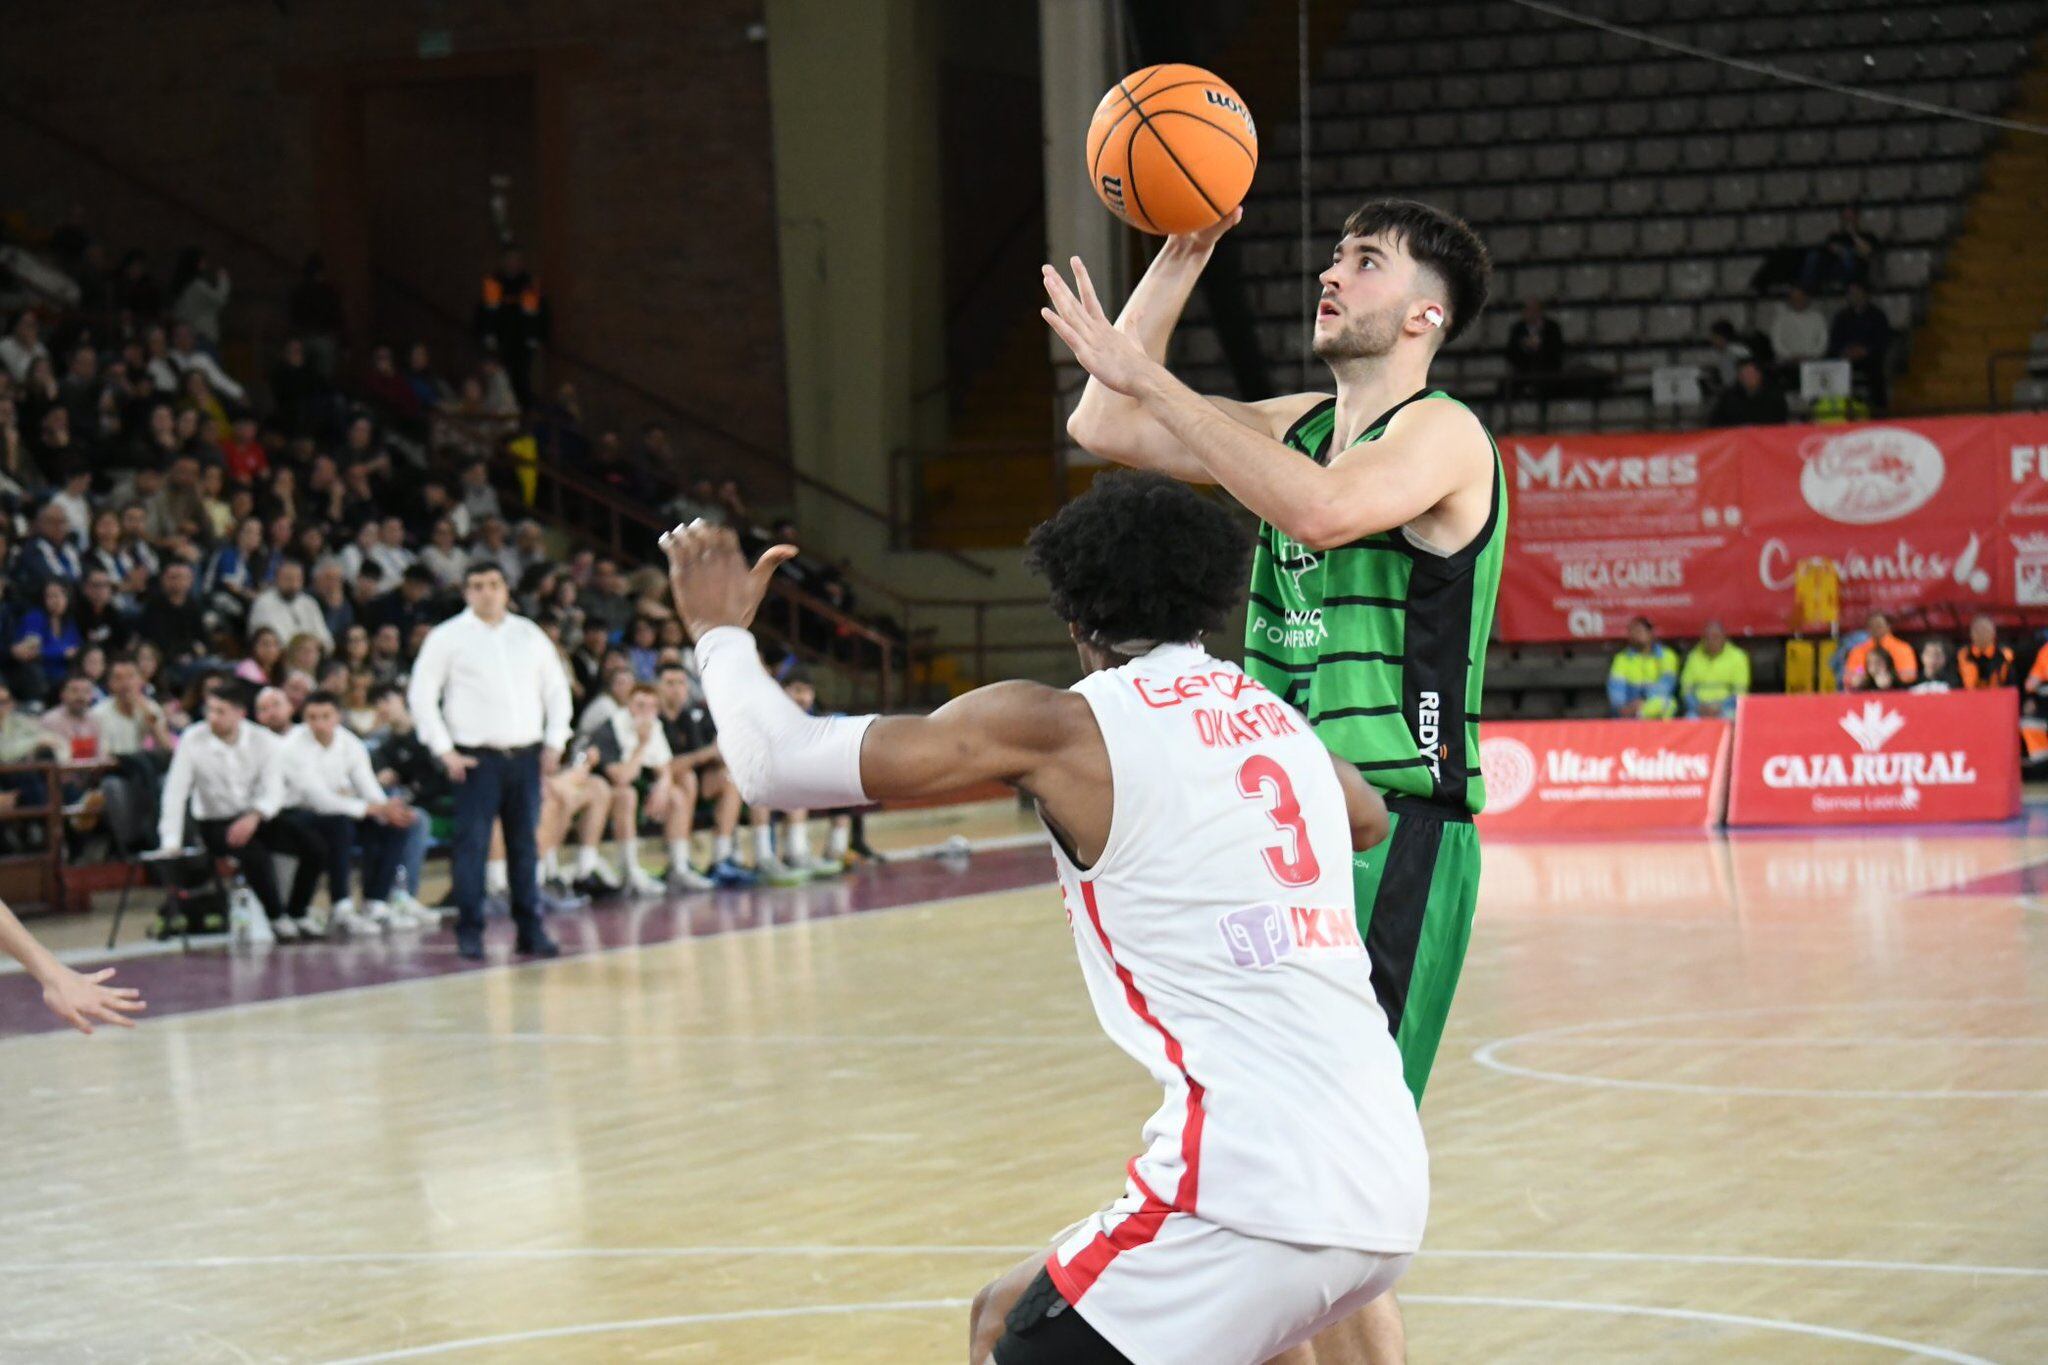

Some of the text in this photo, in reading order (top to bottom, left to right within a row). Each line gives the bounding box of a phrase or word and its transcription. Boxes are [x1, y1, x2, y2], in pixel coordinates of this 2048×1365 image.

[1516, 442, 1698, 490] MAYRES
[1759, 537, 1952, 591] Cvantes
[1191, 702, 1300, 749] OKAFOR
[1618, 747, 1710, 781] Suites
[1762, 751, 1977, 789] CAJA RURAL
[1236, 754, 1321, 888] 3
